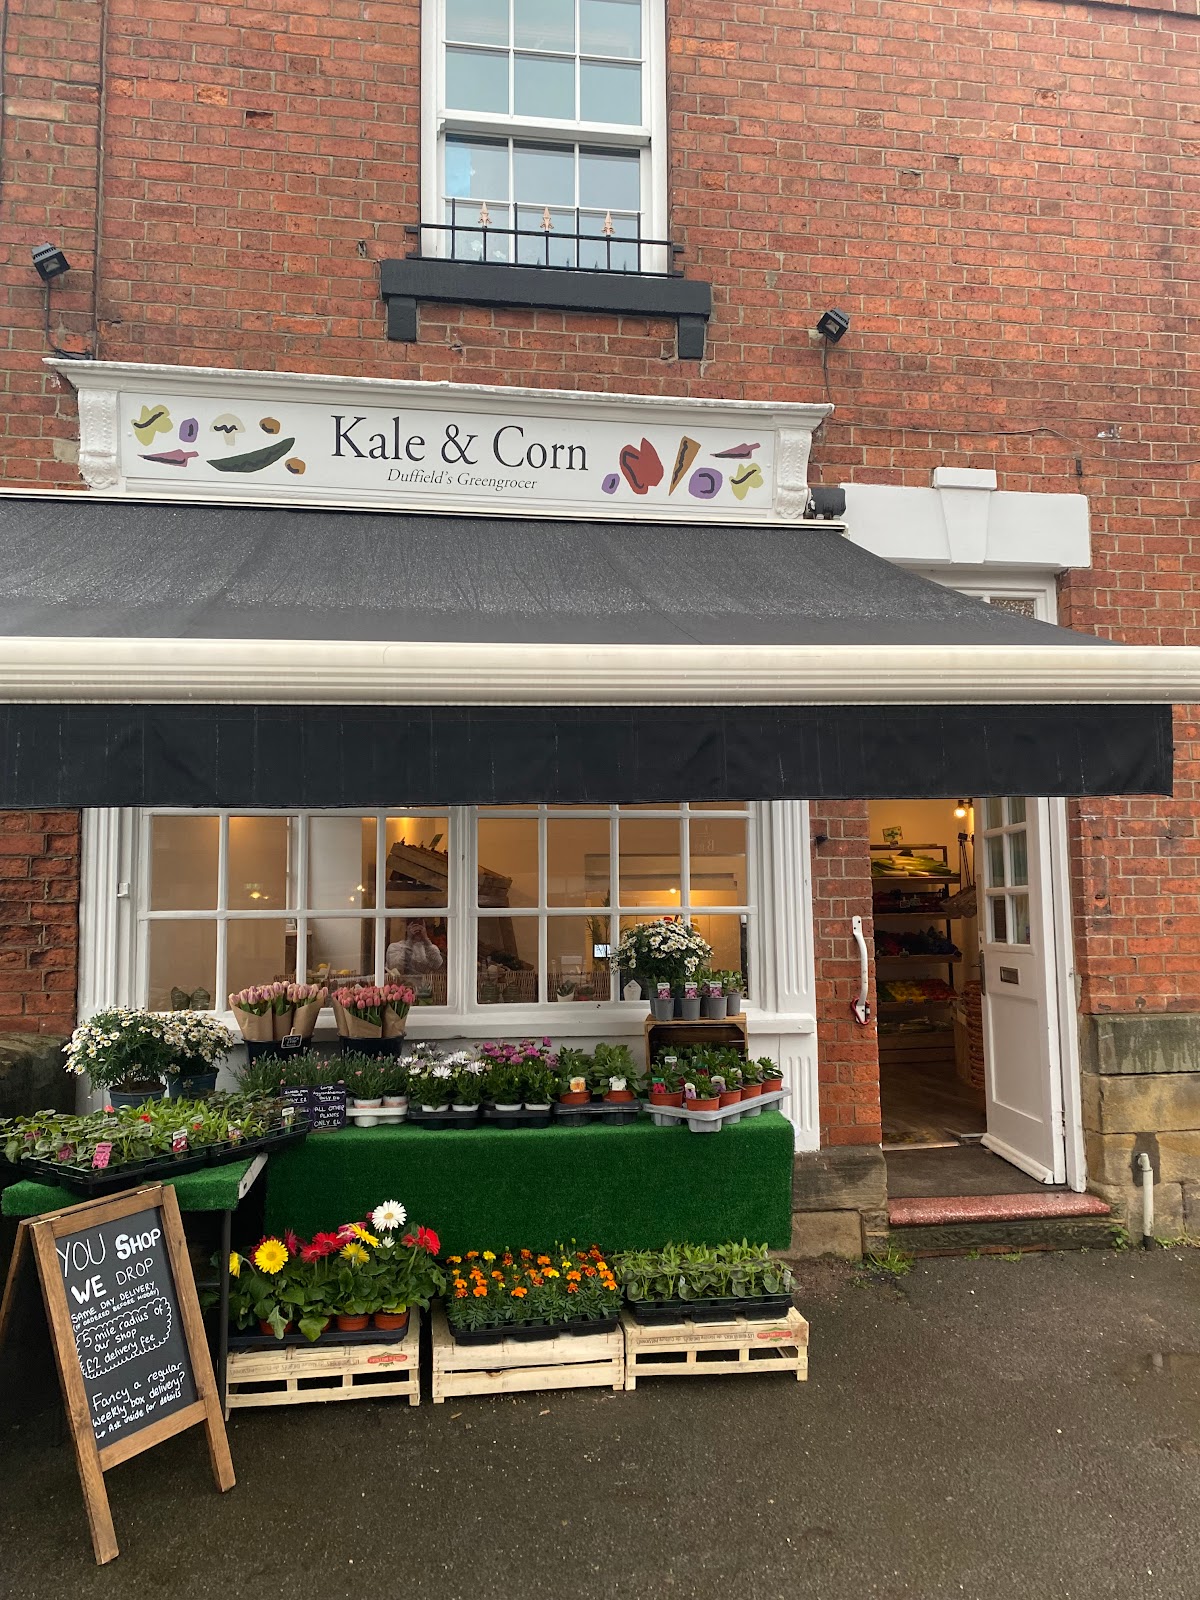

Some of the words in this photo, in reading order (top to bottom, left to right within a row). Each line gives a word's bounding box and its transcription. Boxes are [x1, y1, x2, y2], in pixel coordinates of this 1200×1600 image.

[331, 414, 426, 462] Kale
[440, 423, 479, 465] &
[493, 425, 589, 471] Corn
[387, 468, 453, 484] Duffield's
[457, 472, 538, 491] Greengrocer
[313, 1119, 330, 1128] ONLY
[328, 1104, 345, 1112] OTHER
[55, 1233, 106, 1278] YOU
[115, 1228, 161, 1260] SHOP
[70, 1274, 107, 1304] WE
[115, 1257, 154, 1286] DROP
[71, 1307, 97, 1324] SAME
[100, 1297, 115, 1310] DAY
[119, 1280, 155, 1301] DELIVERY
[82, 1332, 93, 1348] 5
[94, 1326, 117, 1342] mile
[119, 1312, 149, 1330] radius
[153, 1304, 164, 1316] of
[83, 1310, 110, 1326] ORDERED
[112, 1297, 135, 1312] BEFORE
[86, 1356, 101, 1374] £2
[104, 1341, 139, 1364] delivery
[139, 1334, 156, 1349] fee
[94, 1339, 110, 1353] our
[92, 1388, 131, 1412] Fancy
[133, 1381, 142, 1390] a
[147, 1362, 183, 1383] regular
[92, 1404, 128, 1428] weekly
[130, 1395, 146, 1408] box
[148, 1371, 186, 1399] delivery?
[108, 1420, 122, 1433] Ask
[123, 1409, 145, 1424] inside
[145, 1401, 157, 1414] for
[159, 1390, 182, 1406] details
